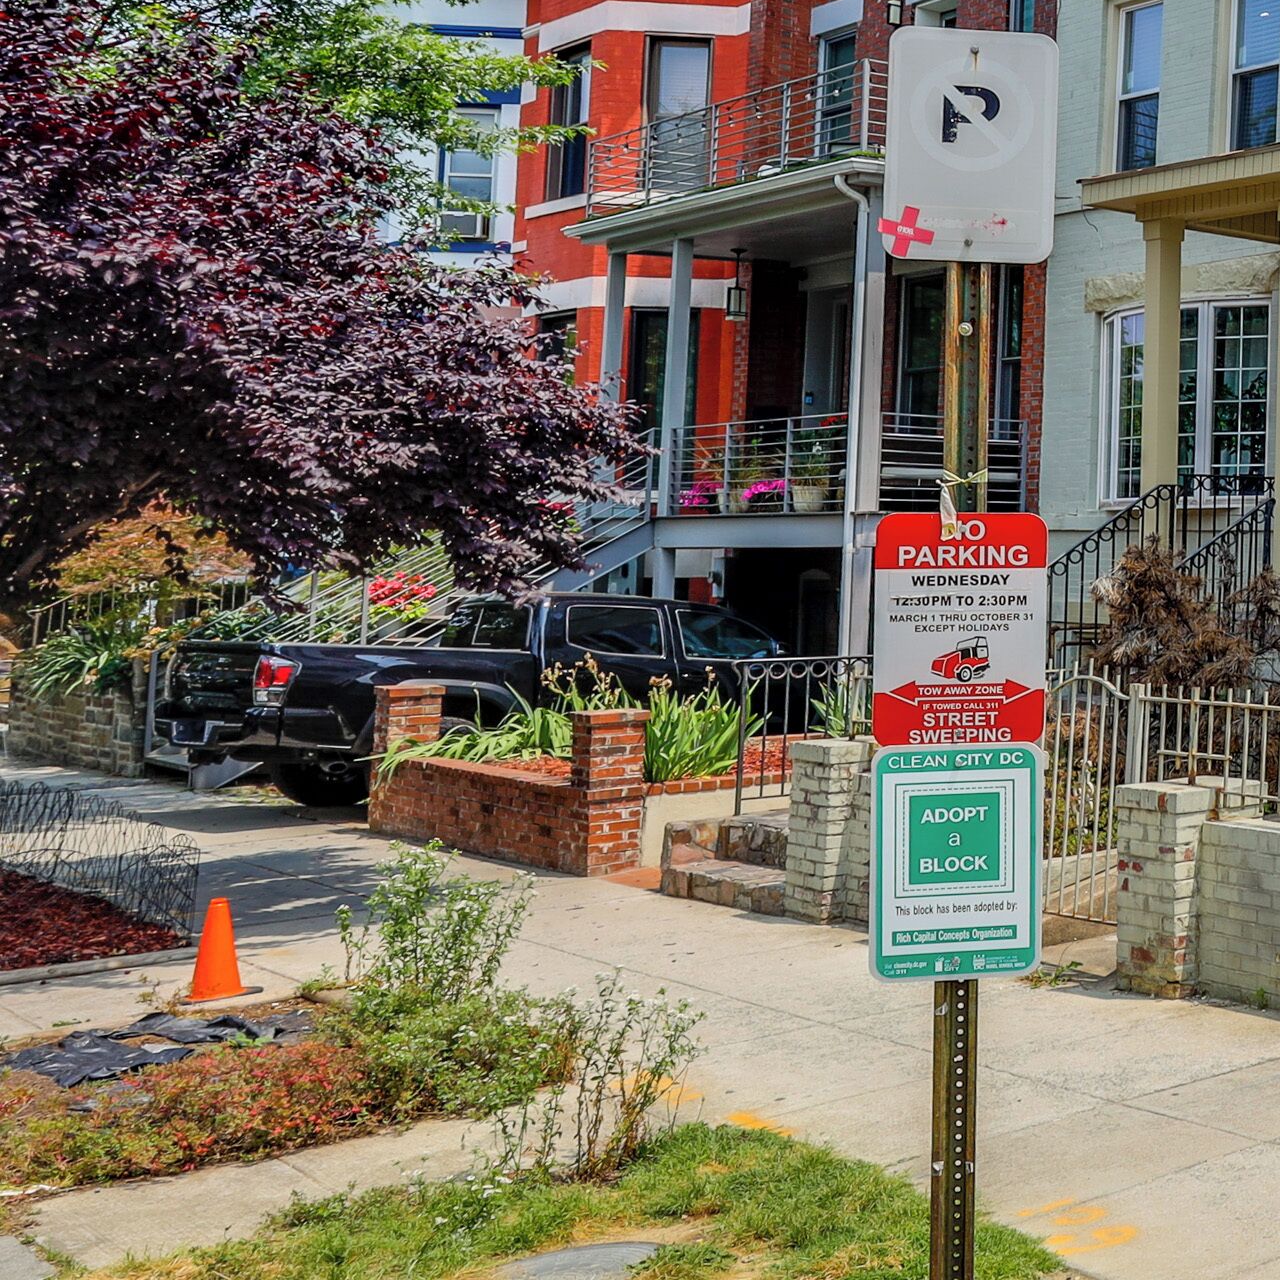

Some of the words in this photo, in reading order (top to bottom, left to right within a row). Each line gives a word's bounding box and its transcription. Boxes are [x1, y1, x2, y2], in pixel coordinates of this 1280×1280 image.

[899, 545, 1029, 566] PARKING
[912, 574, 1010, 586] WEDNESDAY
[956, 596, 974, 606] TO
[979, 595, 1027, 606] 2:30PM
[889, 614, 928, 623] MARCH
[939, 614, 967, 622] THRU
[970, 613, 1020, 621] OCTOBER
[1023, 613, 1034, 621] 31
[915, 624, 955, 632] EXCEPT
[958, 623, 1009, 632] HOLIDAYS
[918, 687, 942, 695] TOW
[944, 686, 973, 695] AWAY
[975, 686, 1003, 694] ZONE
[923, 711, 998, 727] STREET
[909, 727, 1011, 744] SWEEPING
[888, 755, 947, 769] CLEAN
[955, 753, 993, 766] CITY
[1000, 752, 1024, 764] DC
[921, 806, 988, 823] ADOPT
[948, 833, 961, 846] a
[920, 855, 988, 873] BLOCK
[895, 905, 910, 916] This
[913, 904, 933, 915] block
[936, 903, 949, 914] has
[952, 902, 971, 913] been
[974, 901, 1004, 913] adopted
[1006, 900, 1018, 911] by:
[896, 932, 911, 943] Rich
[913, 930, 937, 943] Capital
[938, 929, 970, 942] Concepts
[972, 927, 1013, 940] Organization
